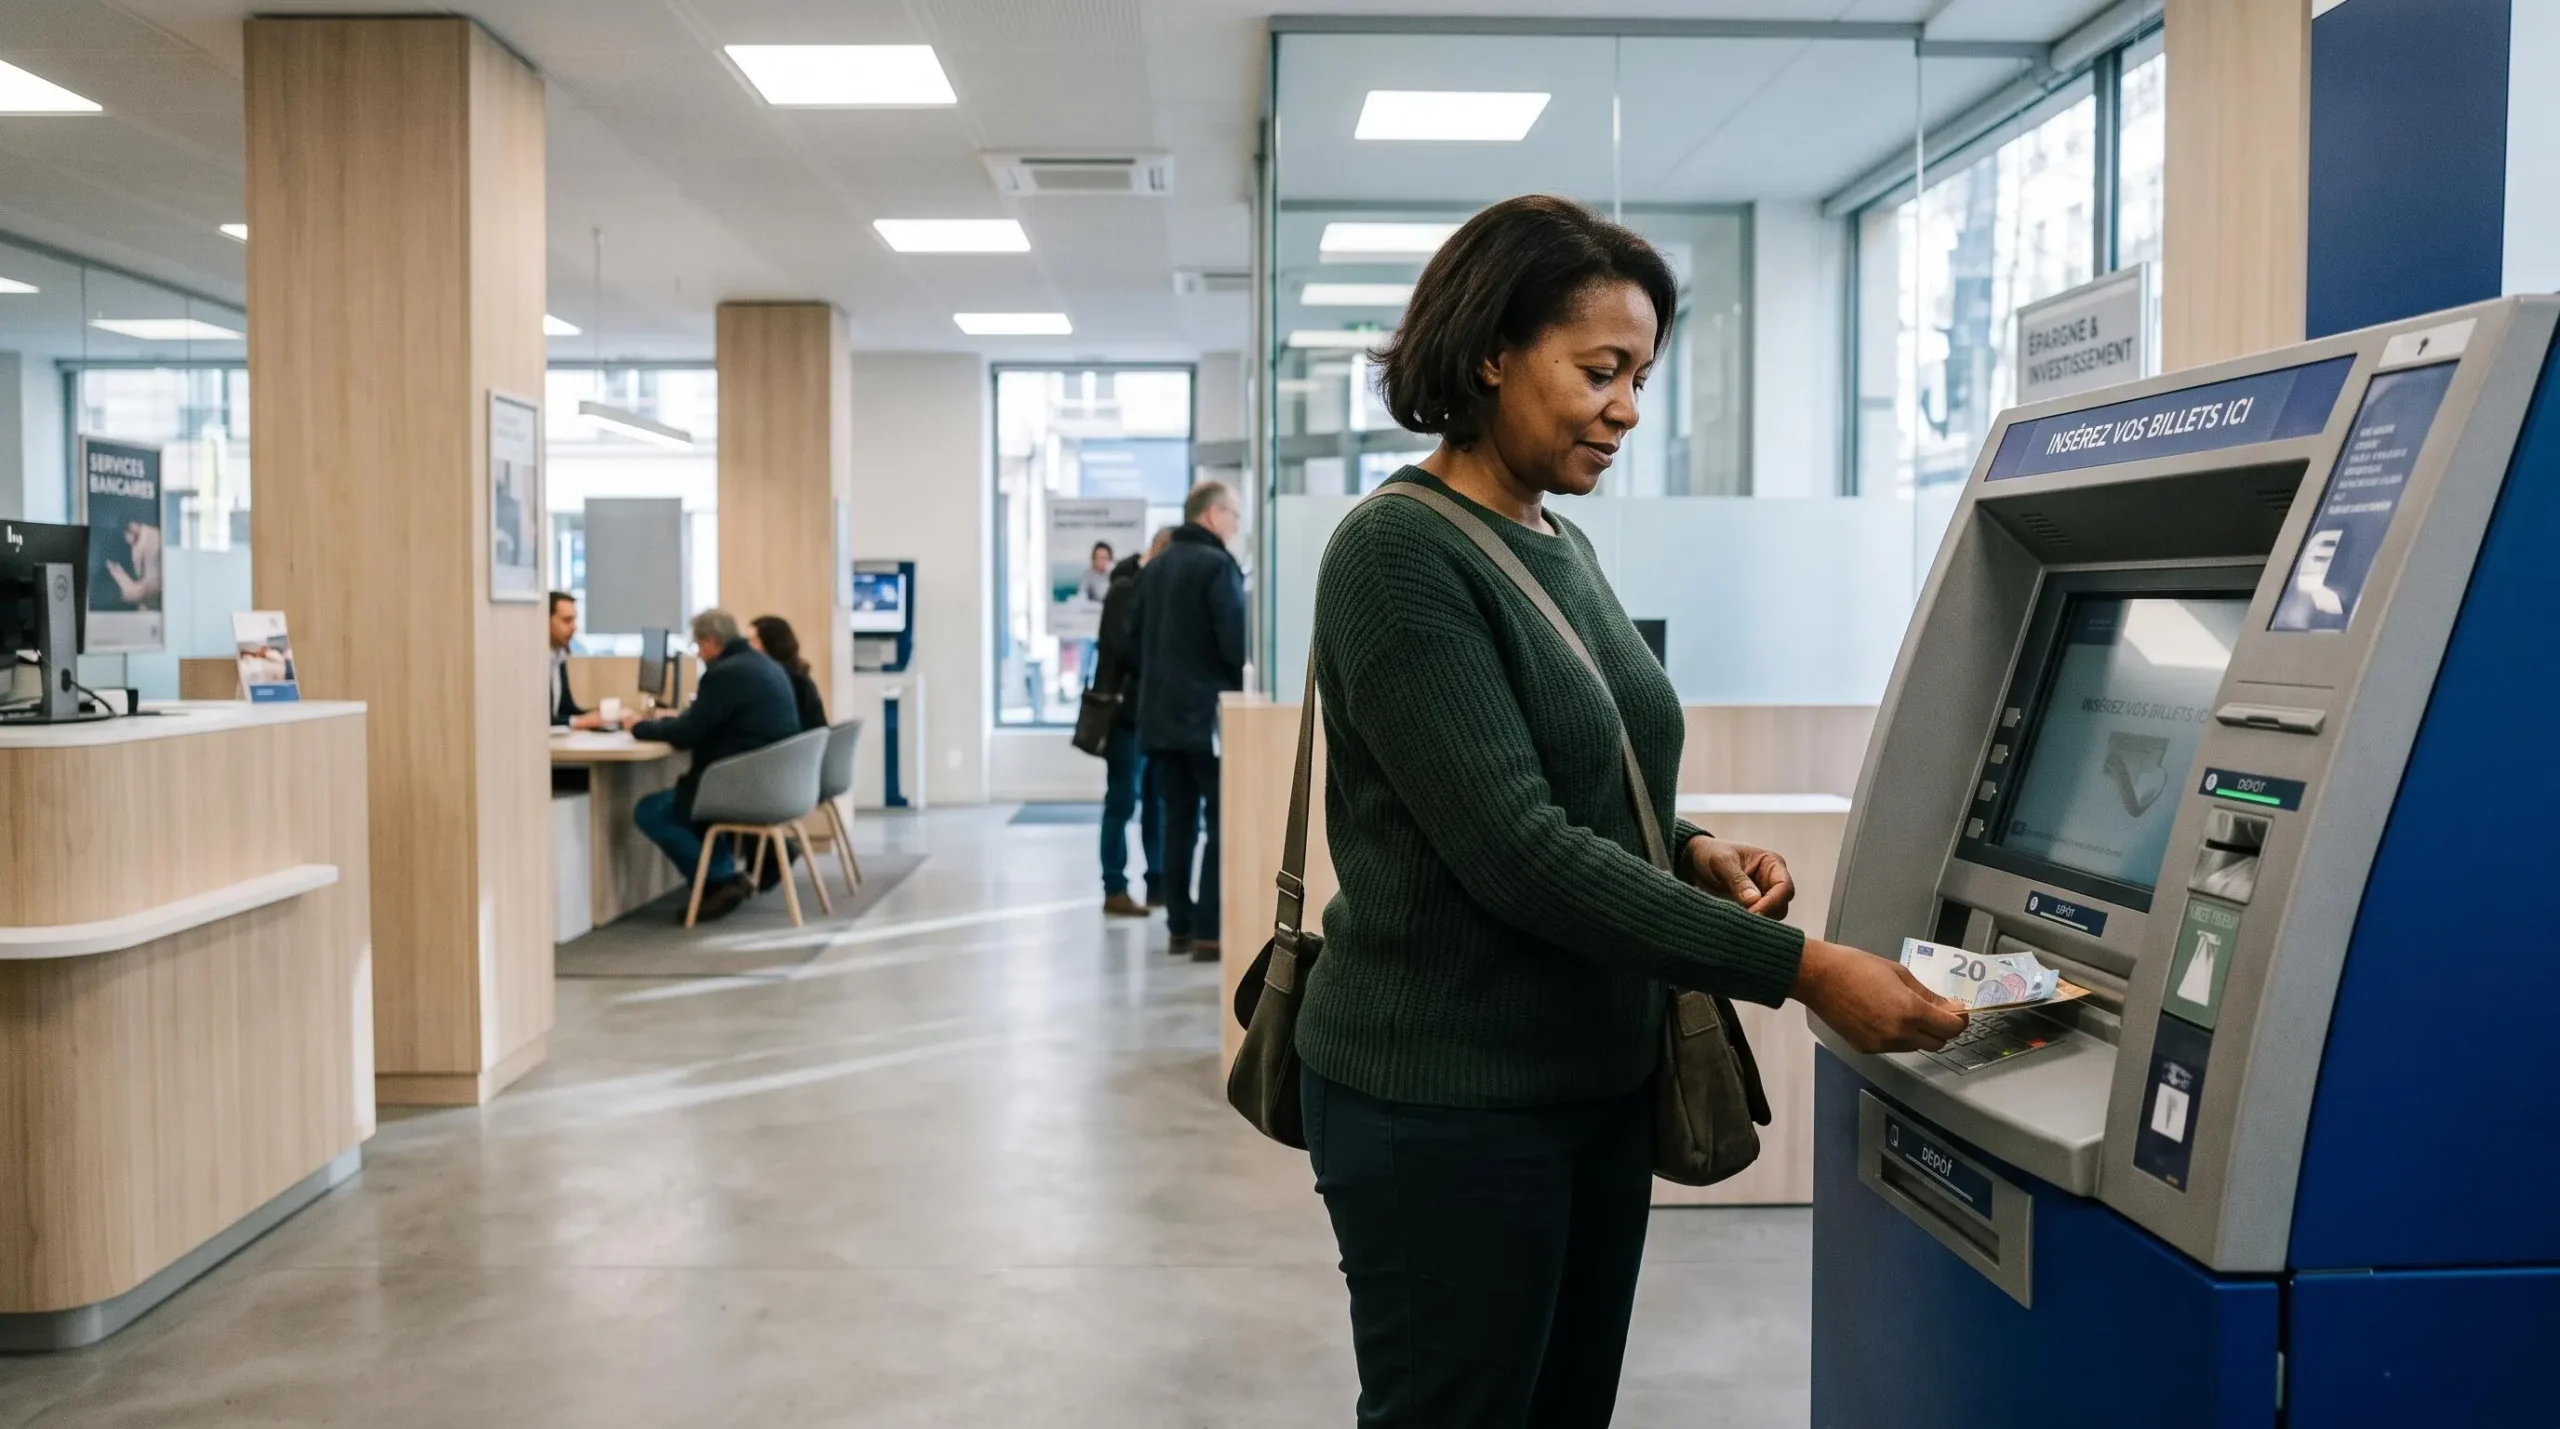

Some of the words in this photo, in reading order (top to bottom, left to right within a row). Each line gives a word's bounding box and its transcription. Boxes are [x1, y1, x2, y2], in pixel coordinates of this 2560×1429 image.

[2028, 317, 2087, 357] ÉPARGNE
[2089, 315, 2099, 340] &
[2028, 336, 2134, 386] INVESTISSEMENT
[2046, 422, 2113, 455] INSÉREZ
[2112, 416, 2149, 444] VOS
[2146, 402, 2223, 439] BILLETS
[2222, 397, 2254, 427] ICI
[89, 452, 145, 479] SERVICES
[89, 473, 155, 500] BANCAIRES
[1949, 953, 1987, 982] 20
